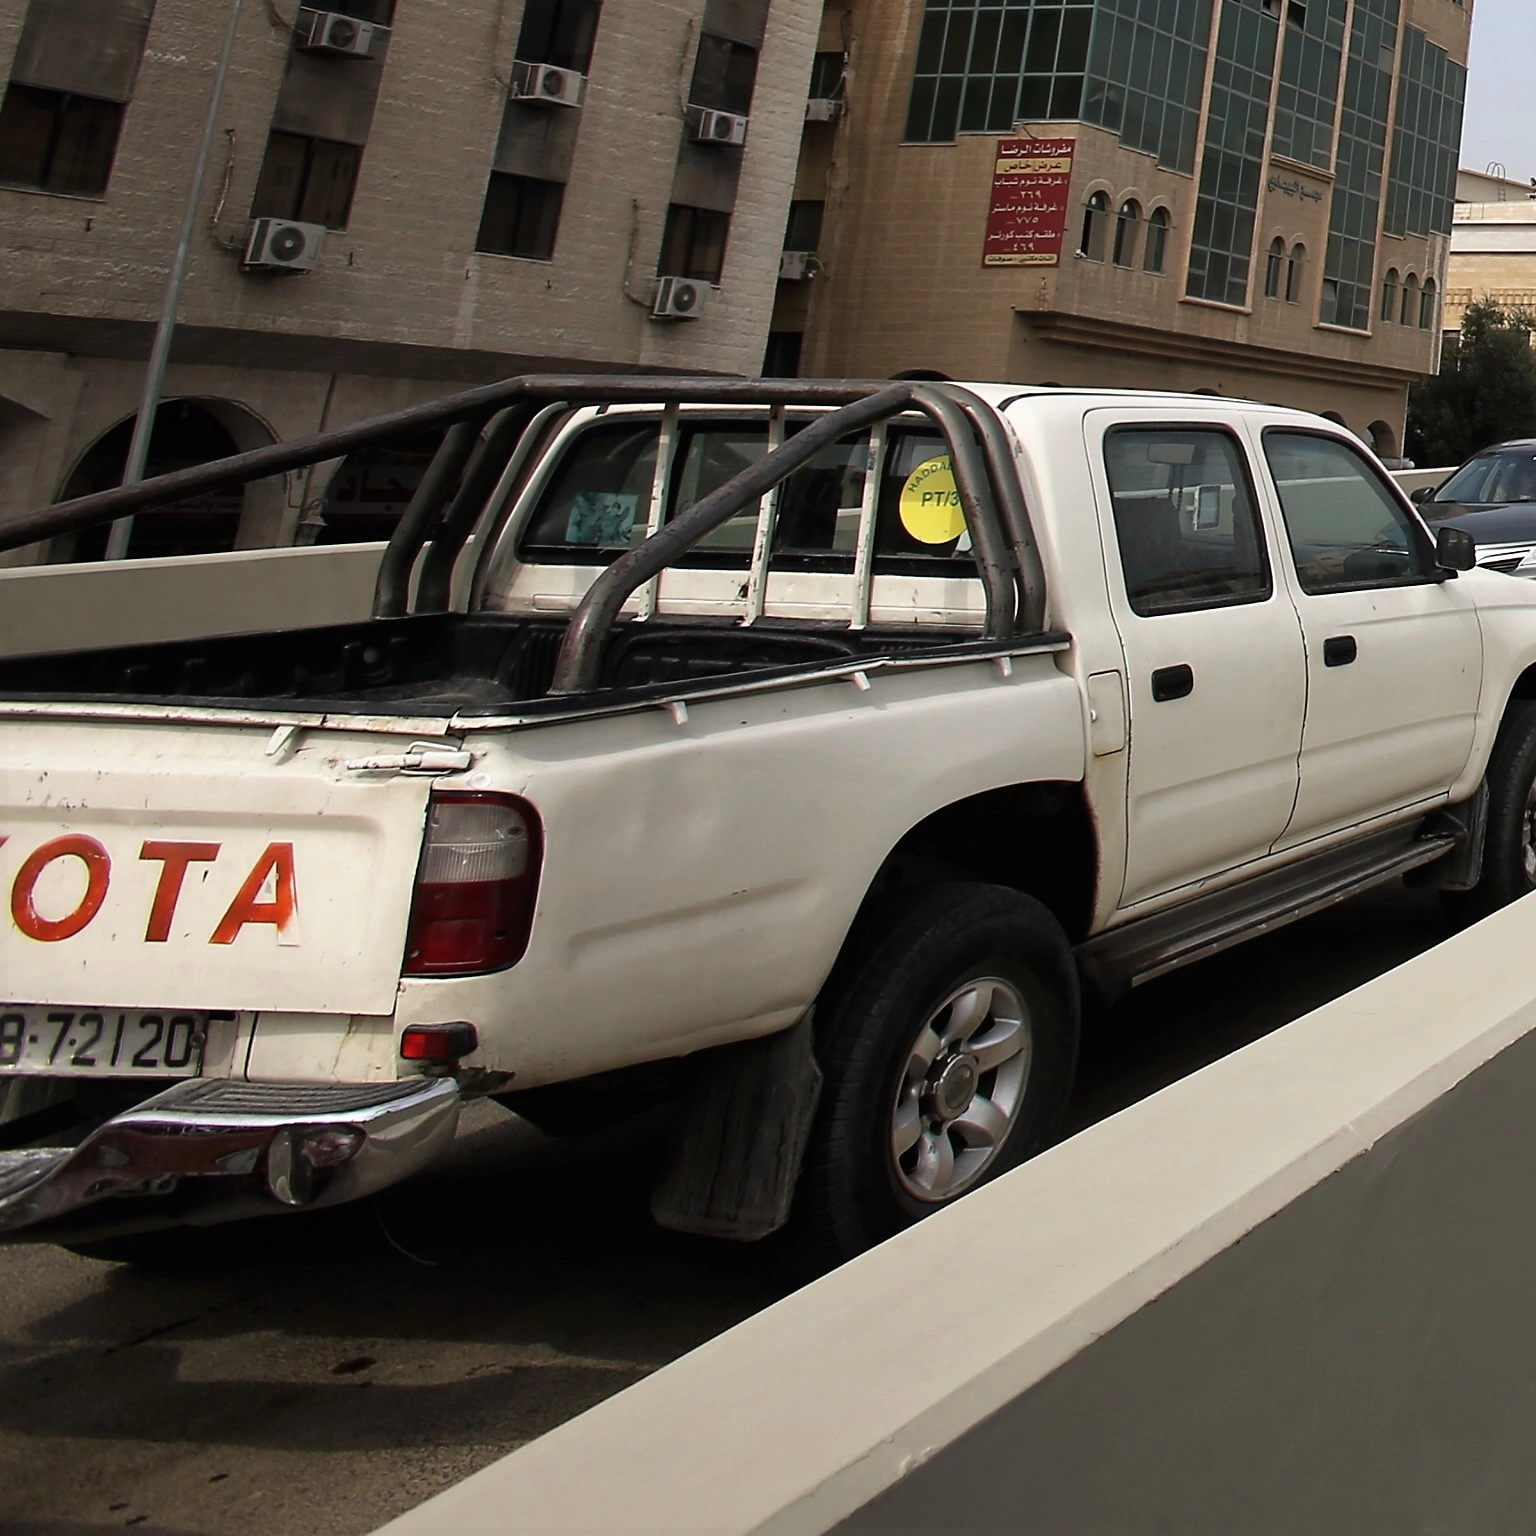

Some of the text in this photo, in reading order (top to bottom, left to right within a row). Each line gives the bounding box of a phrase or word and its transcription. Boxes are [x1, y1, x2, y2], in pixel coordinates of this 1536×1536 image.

[1001, 143, 1072, 157] مفروشات الرضا
[1004, 160, 1062, 172] عرض خاص
[1020, 177, 1037, 187] نوم
[1038, 176, 1063, 186] غرفة
[1016, 203, 1033, 214] نوم
[1034, 203, 1058, 213] غرفة
[0, 834, 298, 947] OTA
